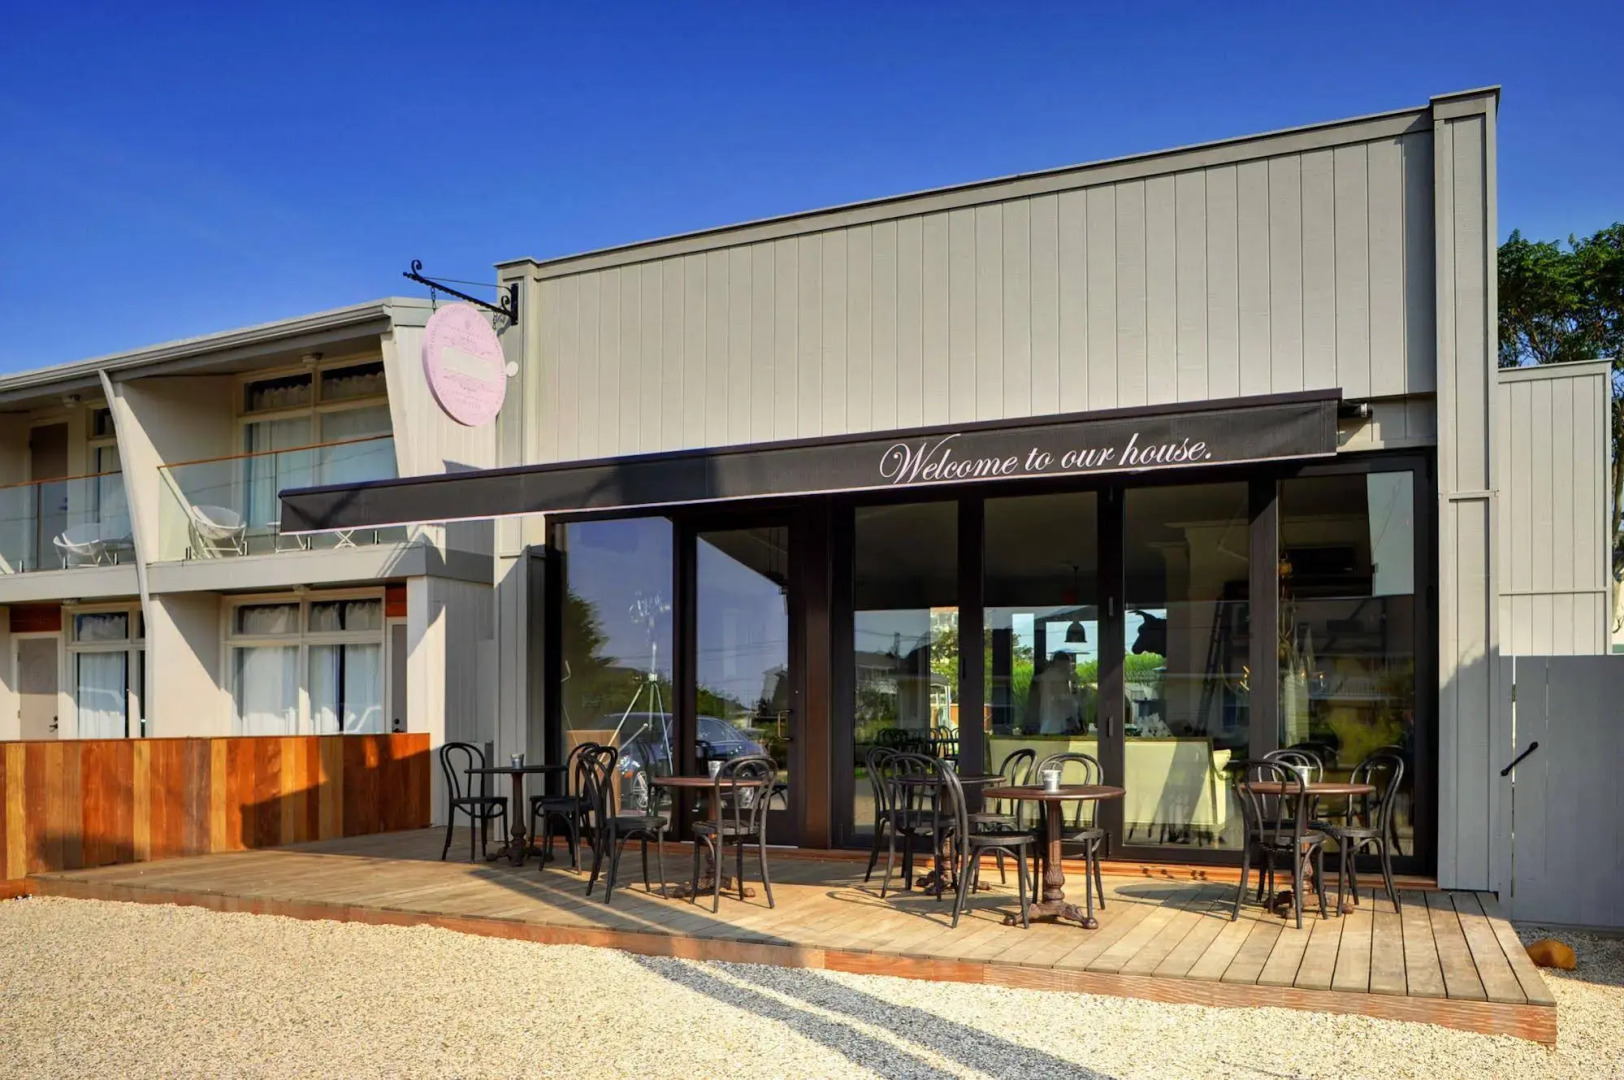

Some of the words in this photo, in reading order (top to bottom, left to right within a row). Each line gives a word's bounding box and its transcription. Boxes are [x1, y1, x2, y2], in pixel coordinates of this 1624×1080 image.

[879, 433, 1018, 485] Welcome
[1024, 447, 1054, 471] to
[1060, 447, 1115, 470] our
[1118, 432, 1213, 467] house.
